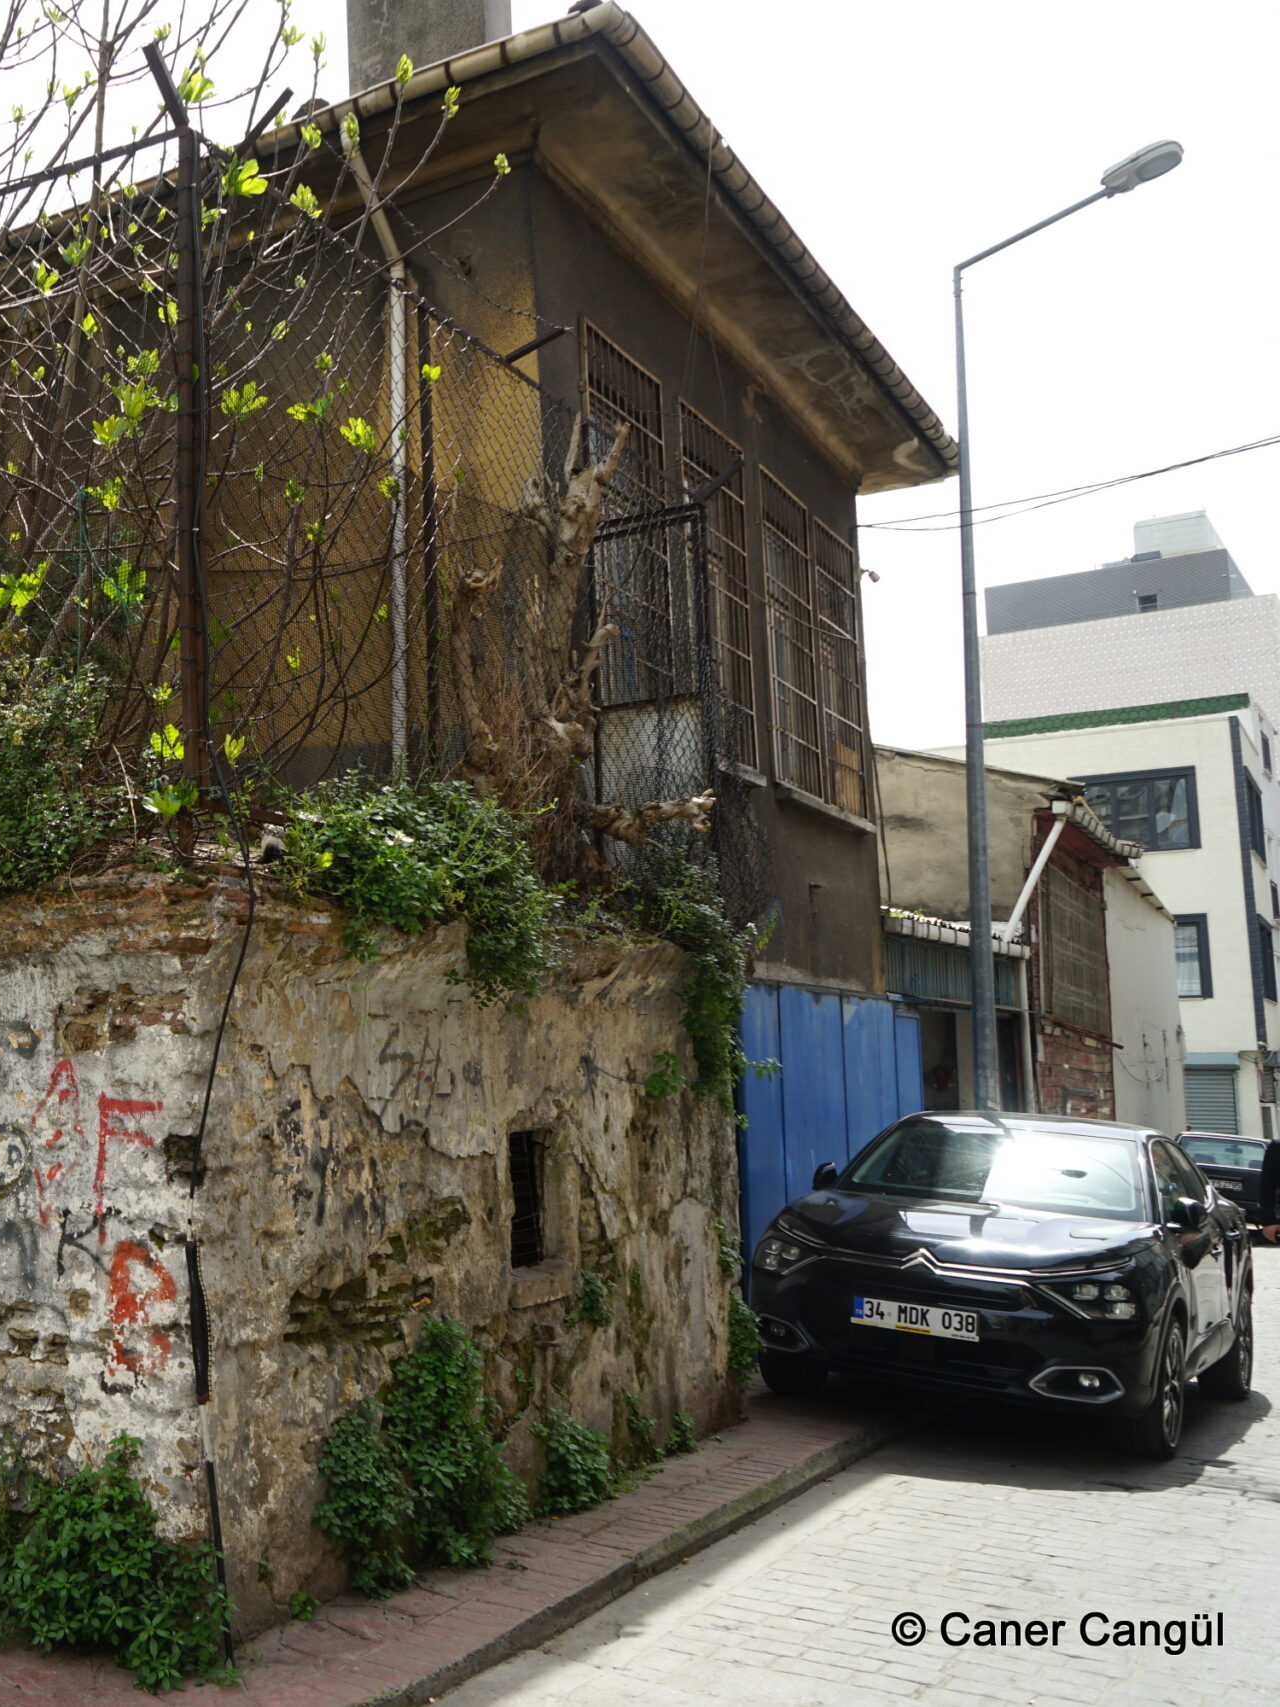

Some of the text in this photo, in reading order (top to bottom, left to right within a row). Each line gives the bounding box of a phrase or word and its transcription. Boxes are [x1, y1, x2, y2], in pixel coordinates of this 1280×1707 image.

[864, 1300, 976, 1334] 34 MDK 038
